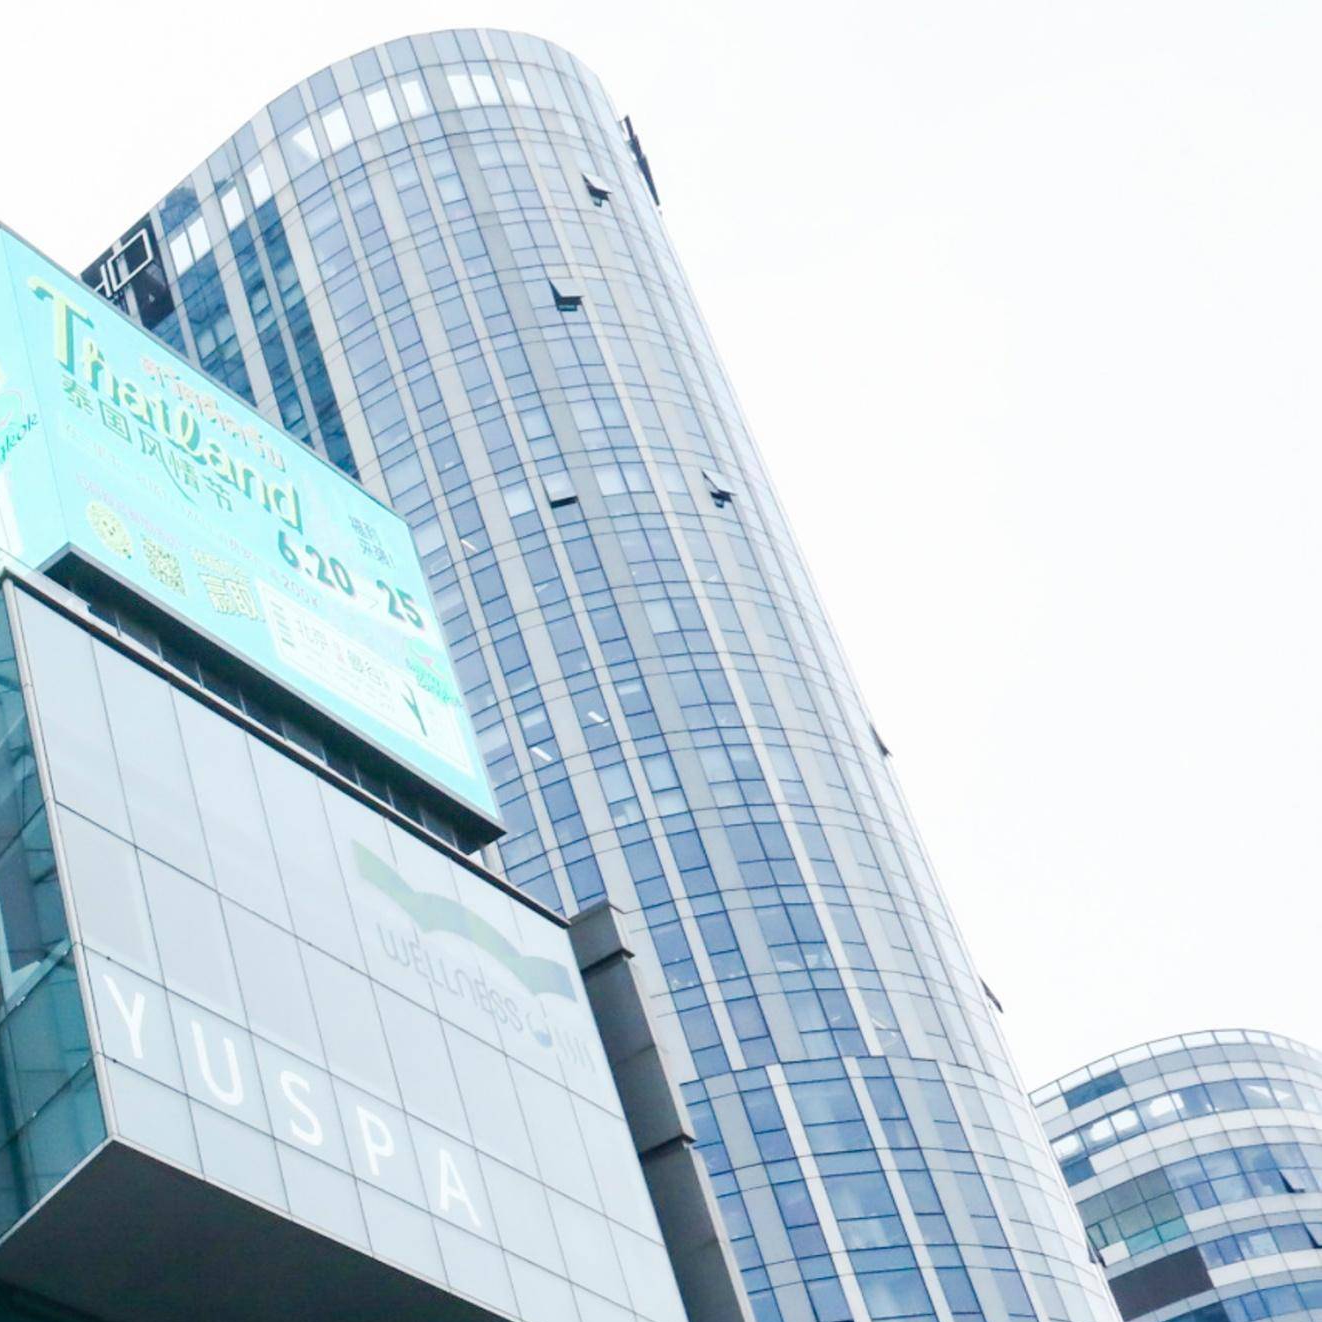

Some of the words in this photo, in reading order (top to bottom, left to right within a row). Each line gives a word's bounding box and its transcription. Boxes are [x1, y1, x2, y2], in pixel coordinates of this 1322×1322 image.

[25, 275, 305, 535] Thailand
[61, 376, 234, 512] 泰国风情节
[277, 529, 355, 597] 6.20
[375, 578, 425, 630] 25
